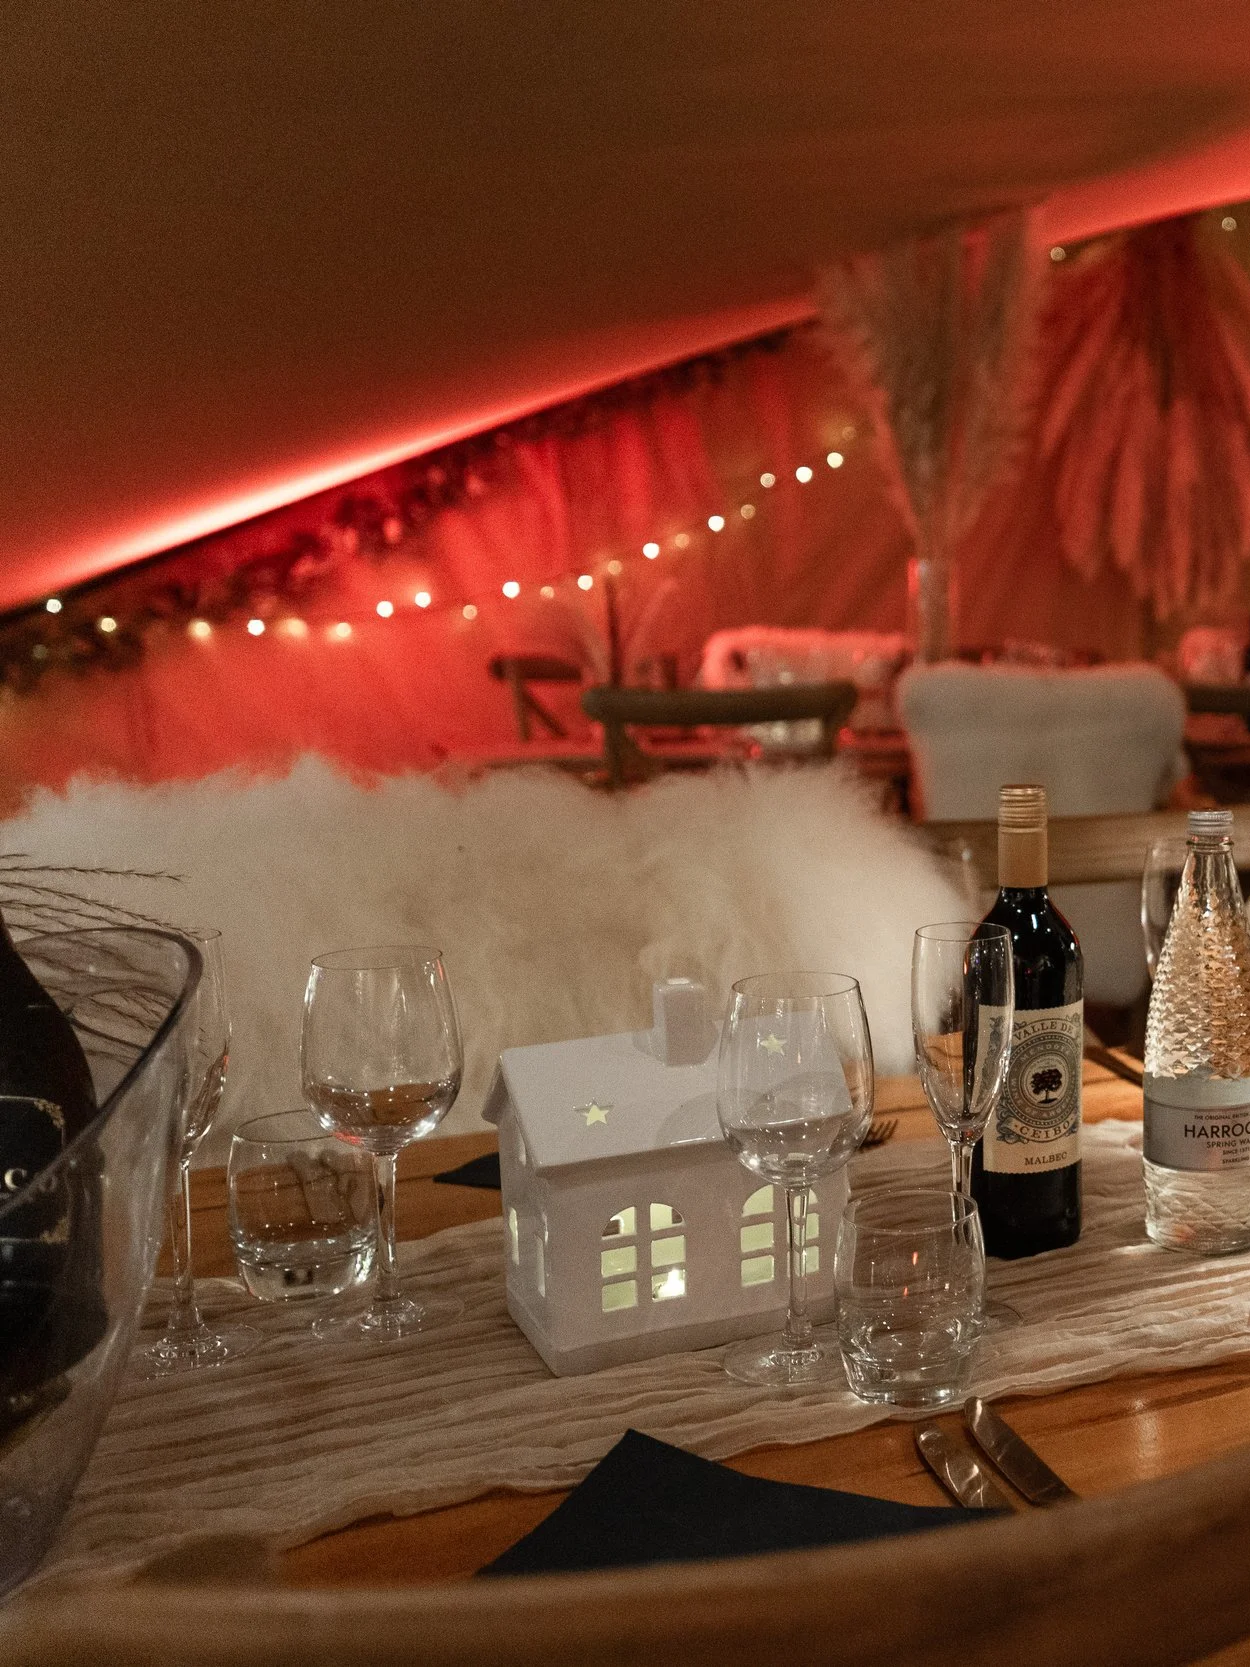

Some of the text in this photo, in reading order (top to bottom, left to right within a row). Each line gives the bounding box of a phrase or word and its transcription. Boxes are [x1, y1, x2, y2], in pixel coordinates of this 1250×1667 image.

[1014, 1022, 1074, 1041] VALLE DE
[1020, 1120, 1070, 1139] CEIBO
[1206, 1140, 1237, 1149] SPRING
[1025, 1152, 1068, 1166] MALBEC
[1222, 1156, 1250, 1164] SPARKLING
